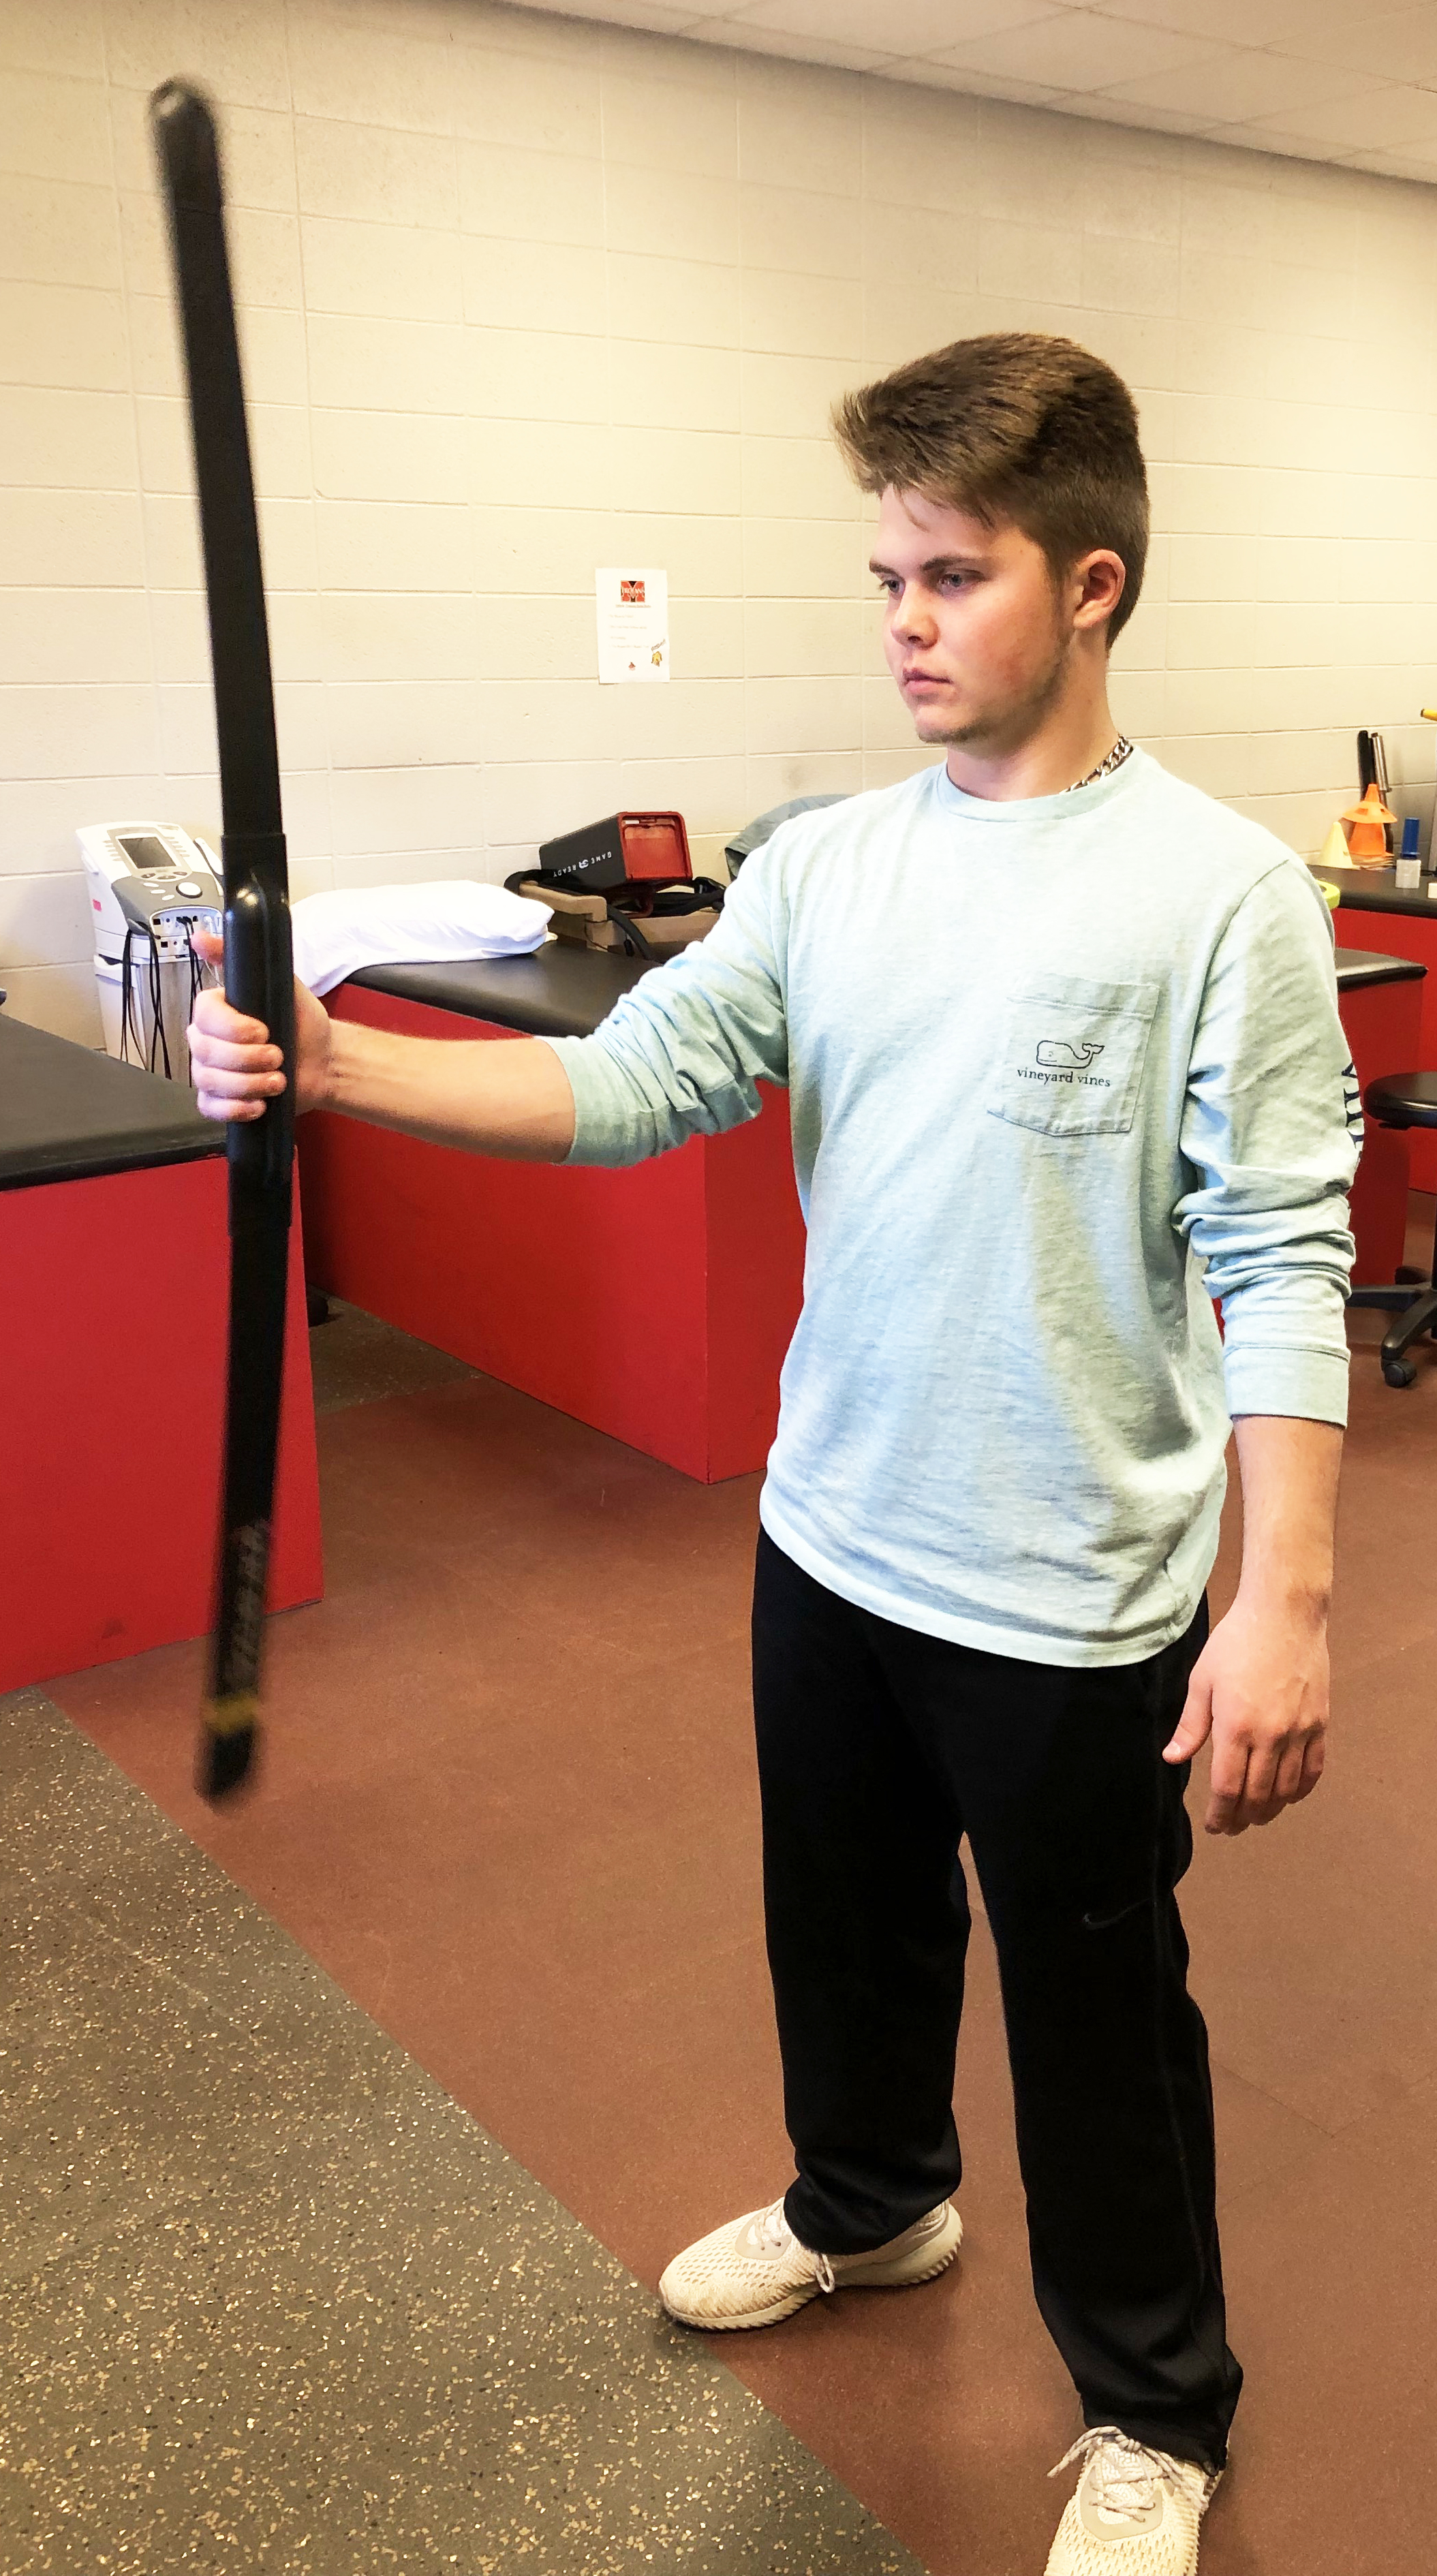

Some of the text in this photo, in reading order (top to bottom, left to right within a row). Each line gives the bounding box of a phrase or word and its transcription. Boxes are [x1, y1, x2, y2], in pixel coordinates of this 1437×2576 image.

[591, 851, 612, 865] GAME
[553, 865, 576, 878] READY
[1017, 1067, 1111, 1087] vineyard vines
